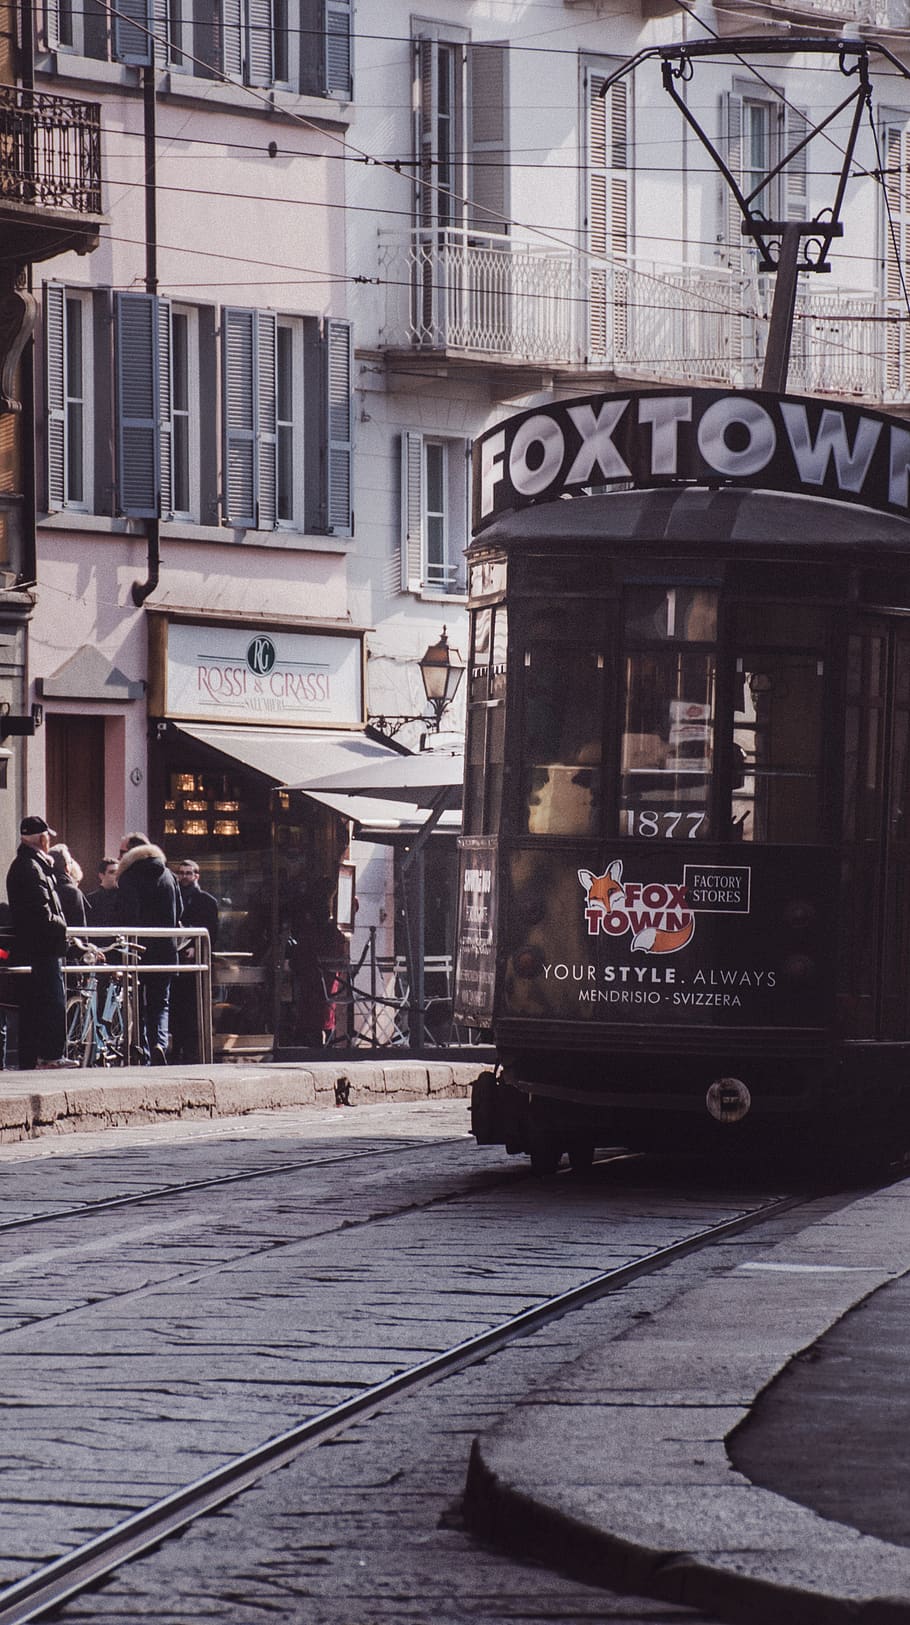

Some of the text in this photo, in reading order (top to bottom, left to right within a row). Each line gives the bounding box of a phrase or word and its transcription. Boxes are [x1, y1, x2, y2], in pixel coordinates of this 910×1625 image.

[198, 666, 247, 703] ROSSI
[269, 672, 330, 703] GRASSI
[625, 808, 706, 839] 1877
[693, 874, 742, 889] FACTORY
[623, 883, 690, 910] FOX
[692, 888, 742, 904] STORES
[585, 909, 692, 936] TOWN
[543, 963, 597, 981] YOUR
[693, 969, 777, 988] ALWAYS
